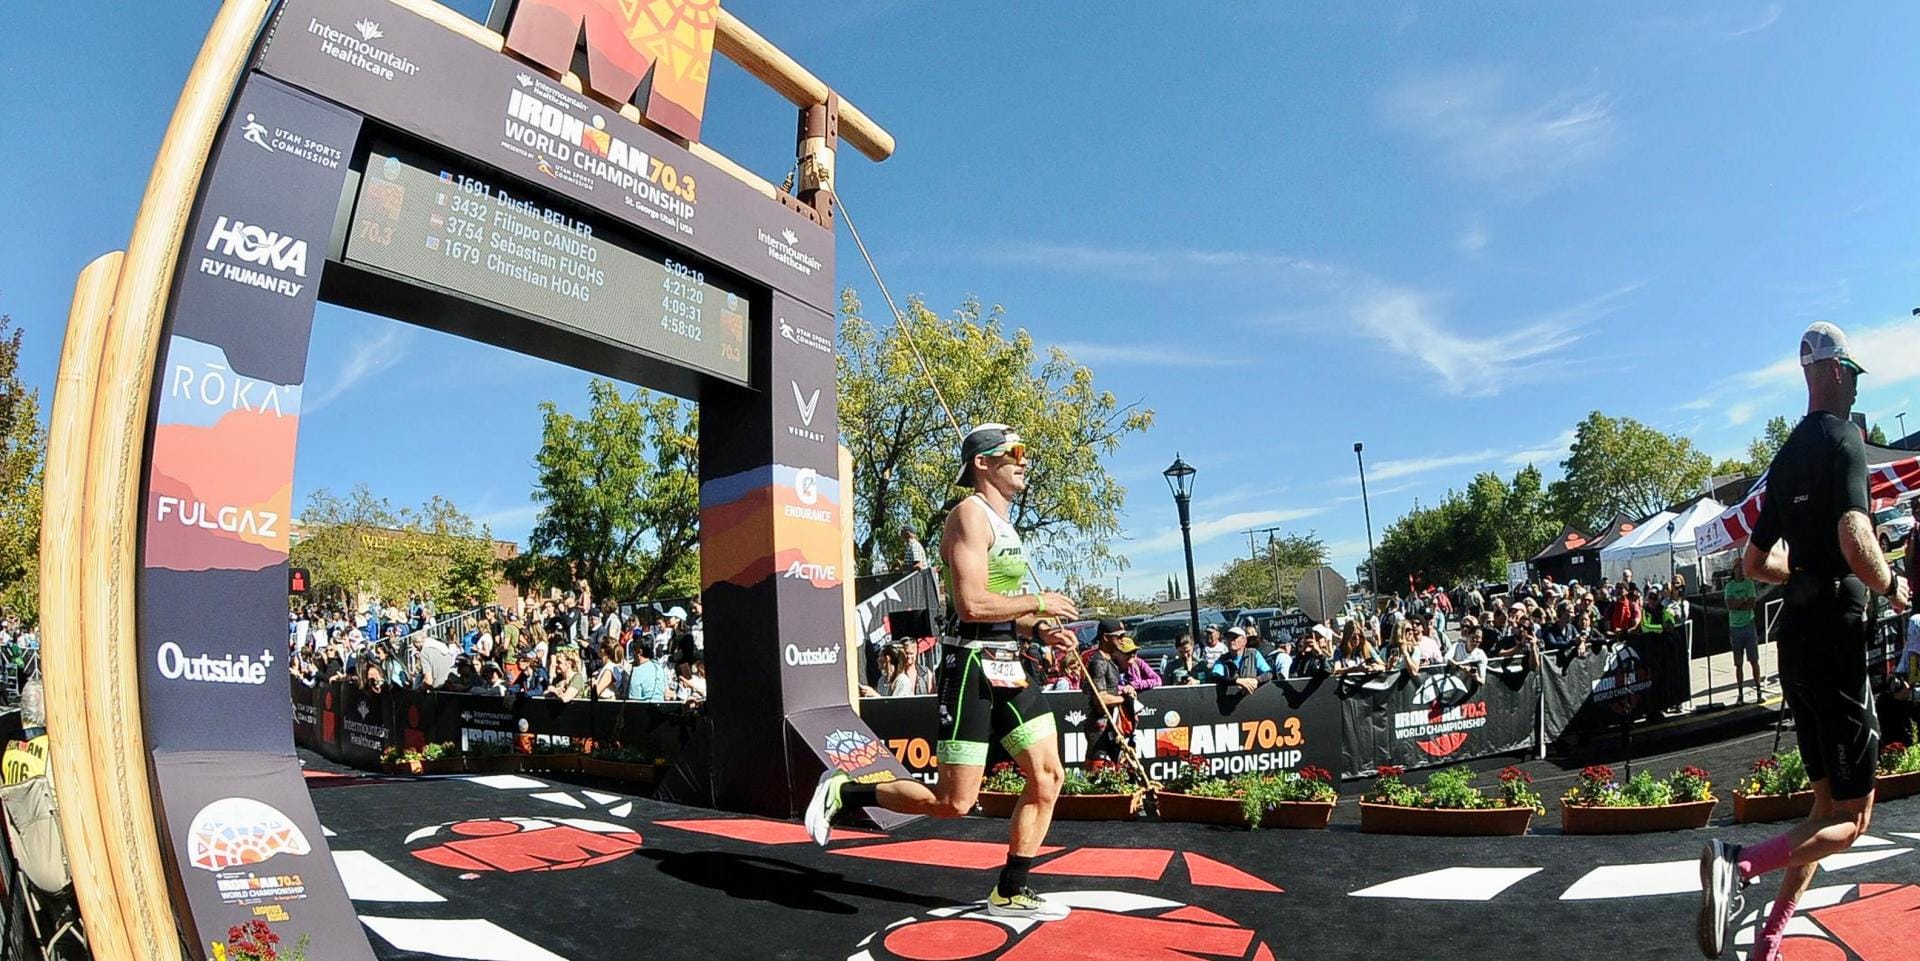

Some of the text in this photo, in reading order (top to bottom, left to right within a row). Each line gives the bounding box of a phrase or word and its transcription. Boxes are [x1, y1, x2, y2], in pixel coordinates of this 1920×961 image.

[307, 17, 419, 77] Intermountain
[320, 39, 395, 81] Healthcare
[533, 87, 570, 110] Healthcare
[535, 79, 589, 112] Intermountain
[271, 138, 339, 170] COMMISSION
[274, 128, 342, 160] UTAH SPORTS
[505, 118, 695, 220] WORLD CHAMPIONSHIP
[650, 157, 698, 203] 70.3
[206, 216, 308, 277] HOKA
[457, 175, 705, 286] 1691 Dustin BELLER 5:02:19
[451, 196, 703, 304] 3432 Filippo CANDEO 4:21:20
[757, 228, 822, 271] Intermountain
[768, 247, 811, 276] Healthcare
[201, 258, 304, 298] FLY HUMAN FLY
[447, 217, 702, 322] 3754 Sebastian FUCHS 4:09:31
[444, 239, 702, 341] 1679 Christian HOAG 4:58:02
[788, 426, 825, 443] VINFAST
[157, 496, 277, 537] FULGAZ
[784, 506, 831, 523] ENDURANCE
[783, 560, 835, 580] ACTIVE
[1269, 618, 1298, 628] Parking
[1461, 700, 1487, 719] 70.3
[1243, 717, 1304, 750] 70.3
[1395, 717, 1487, 740] WORLD CHAMPIONSHIP
[889, 738, 938, 768] 70.
[221, 890, 249, 900] WORLD
[249, 886, 305, 898] CHAMPIONSHIP
